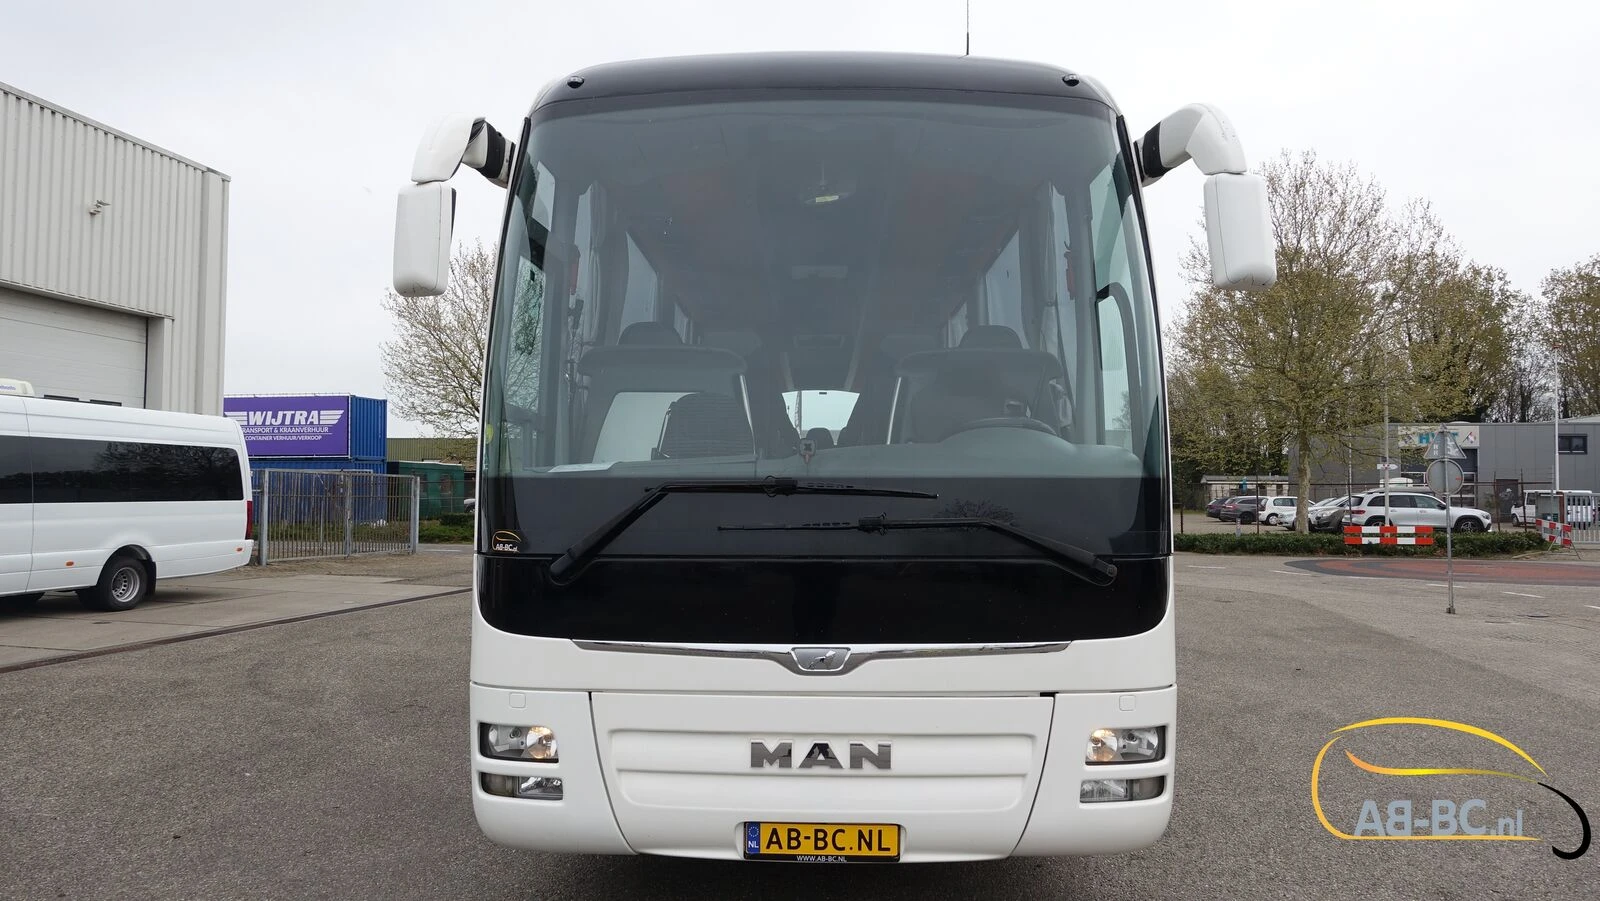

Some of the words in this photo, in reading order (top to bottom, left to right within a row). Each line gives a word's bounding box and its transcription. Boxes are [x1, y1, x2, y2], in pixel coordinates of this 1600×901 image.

[249, 410, 319, 425] WIJTRA
[750, 740, 891, 769] MAN
[748, 840, 759, 849] NL
[765, 827, 891, 852] AB-BC.NL
[796, 855, 848, 863] WWW.AB-BC.NL
